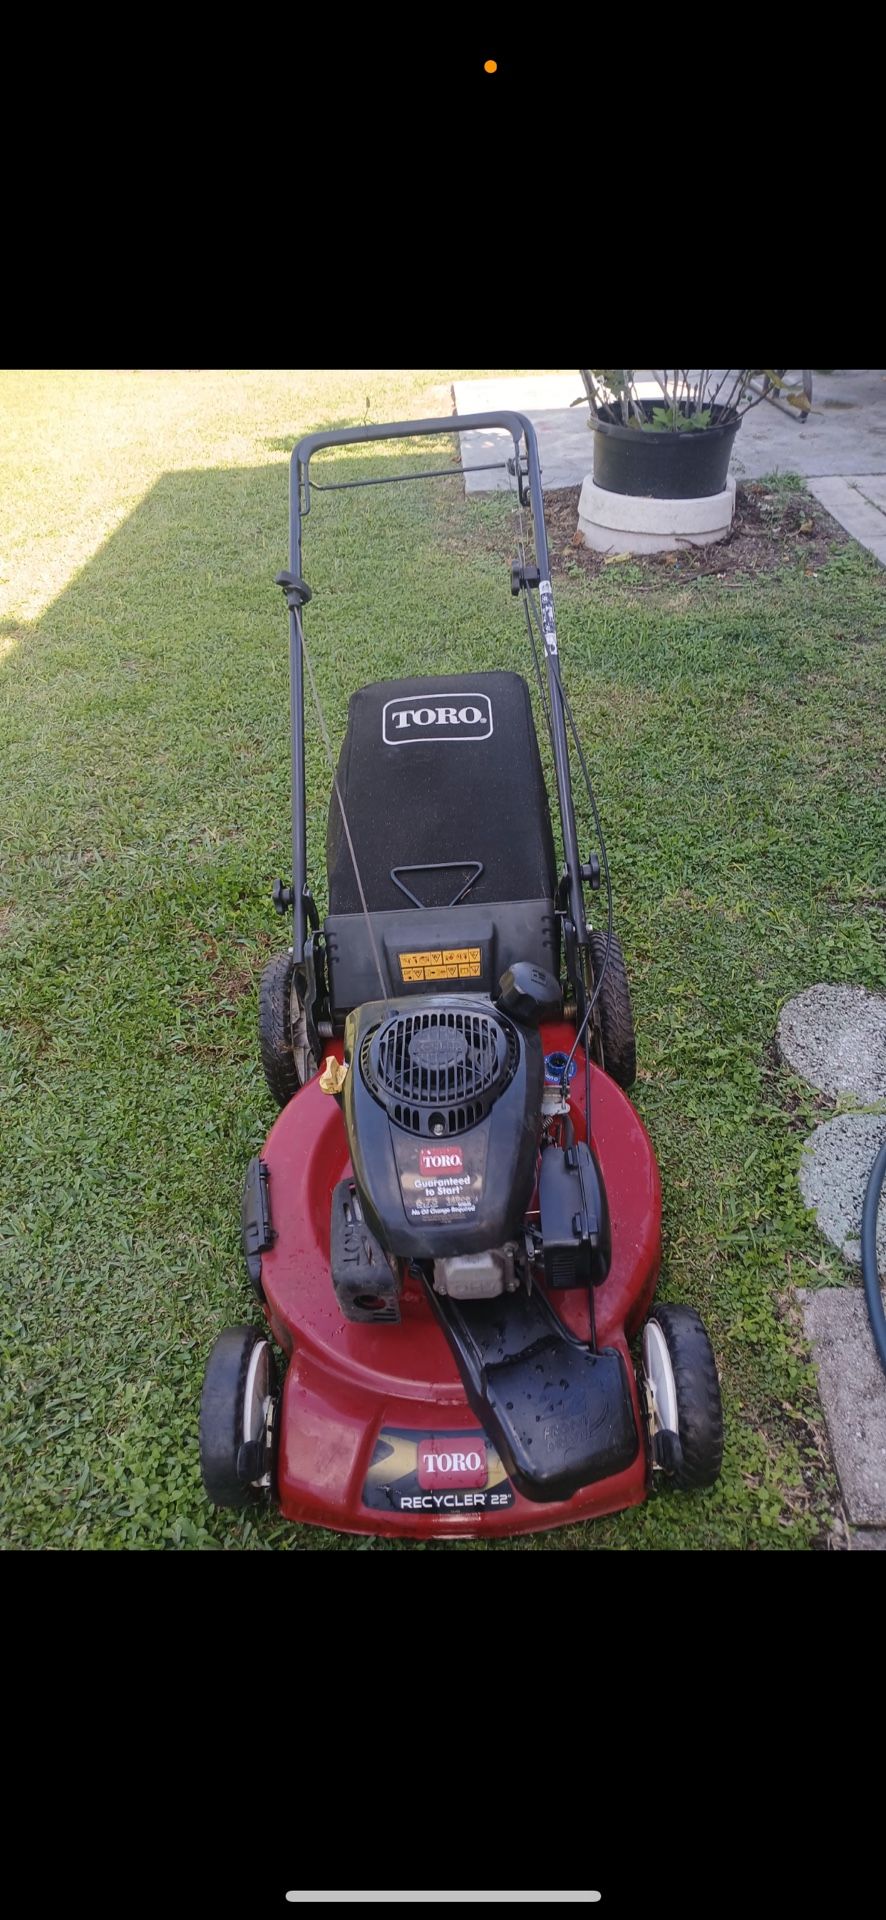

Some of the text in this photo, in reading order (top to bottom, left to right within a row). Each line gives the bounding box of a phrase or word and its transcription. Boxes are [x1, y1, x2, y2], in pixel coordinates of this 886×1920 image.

[392, 707, 482, 729] TORO
[423, 1154, 462, 1168] TORO
[414, 1175, 471, 1188] Guaranteed
[425, 1188, 435, 1197] to
[423, 1452, 481, 1473] TORO
[401, 1494, 486, 1509] RECYCLER
